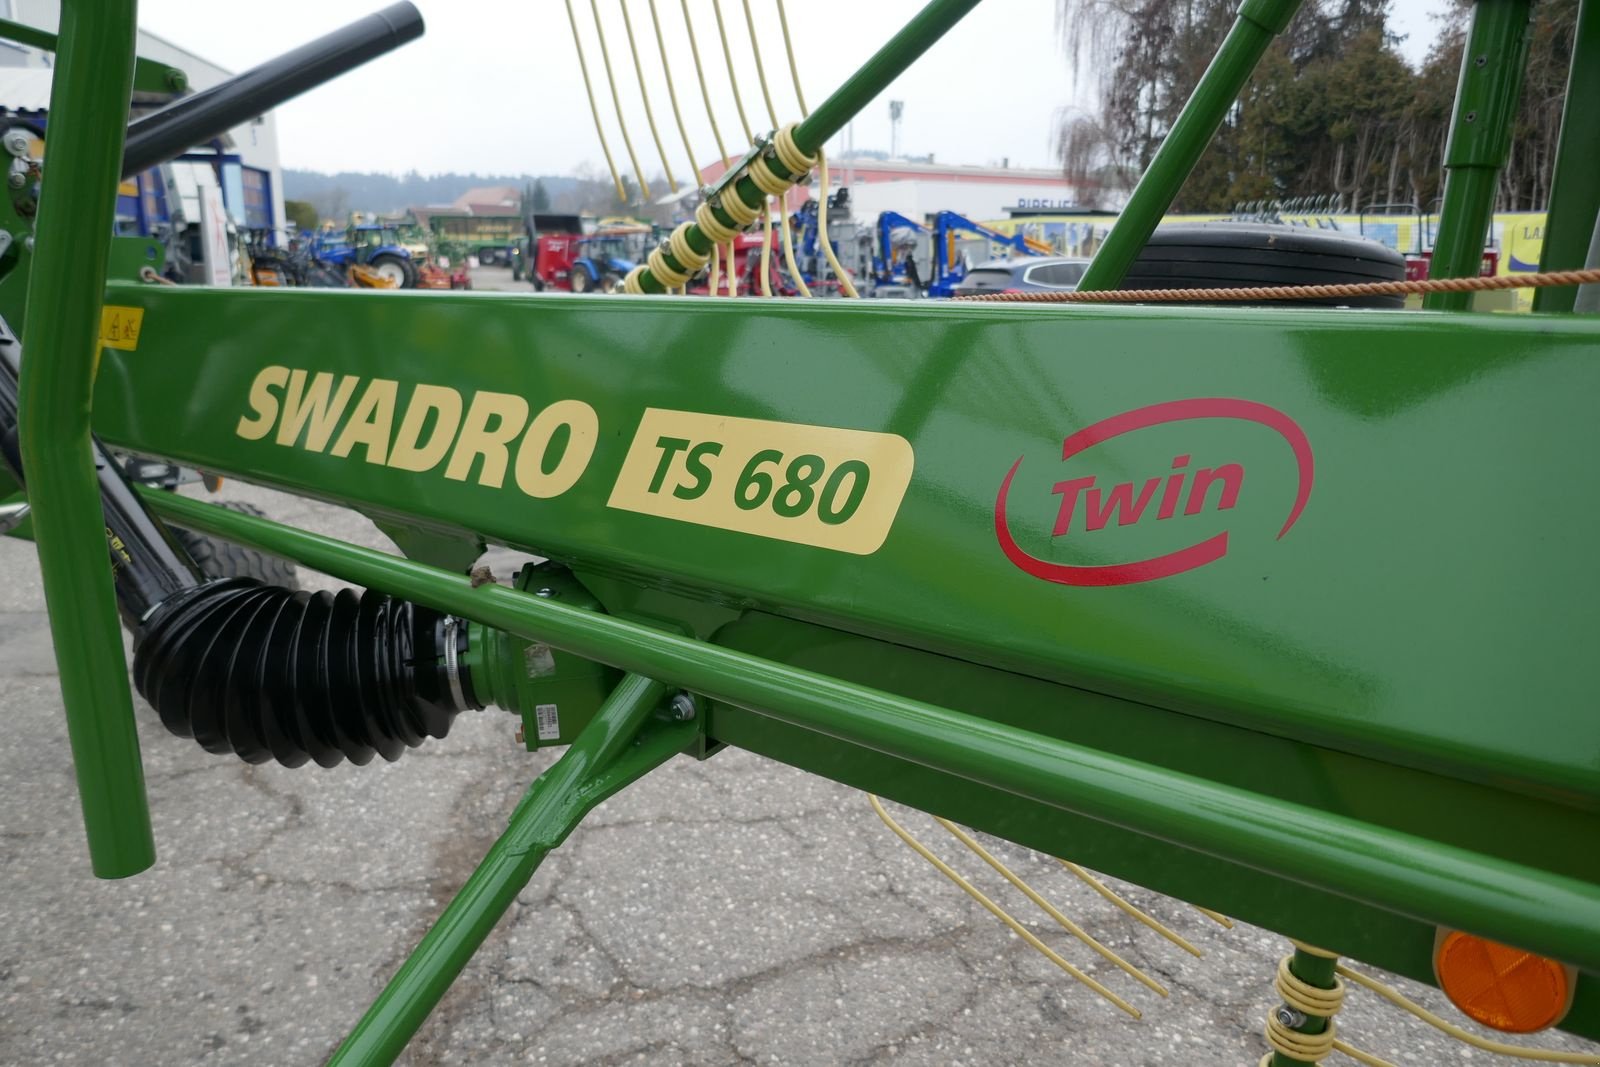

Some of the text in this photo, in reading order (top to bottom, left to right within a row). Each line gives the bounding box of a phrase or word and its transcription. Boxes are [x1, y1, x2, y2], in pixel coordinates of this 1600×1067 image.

[1523, 226, 1544, 240] LA
[235, 365, 599, 499] SWADRO
[647, 436, 871, 525] TS 680
[1051, 454, 1244, 537] Twin
